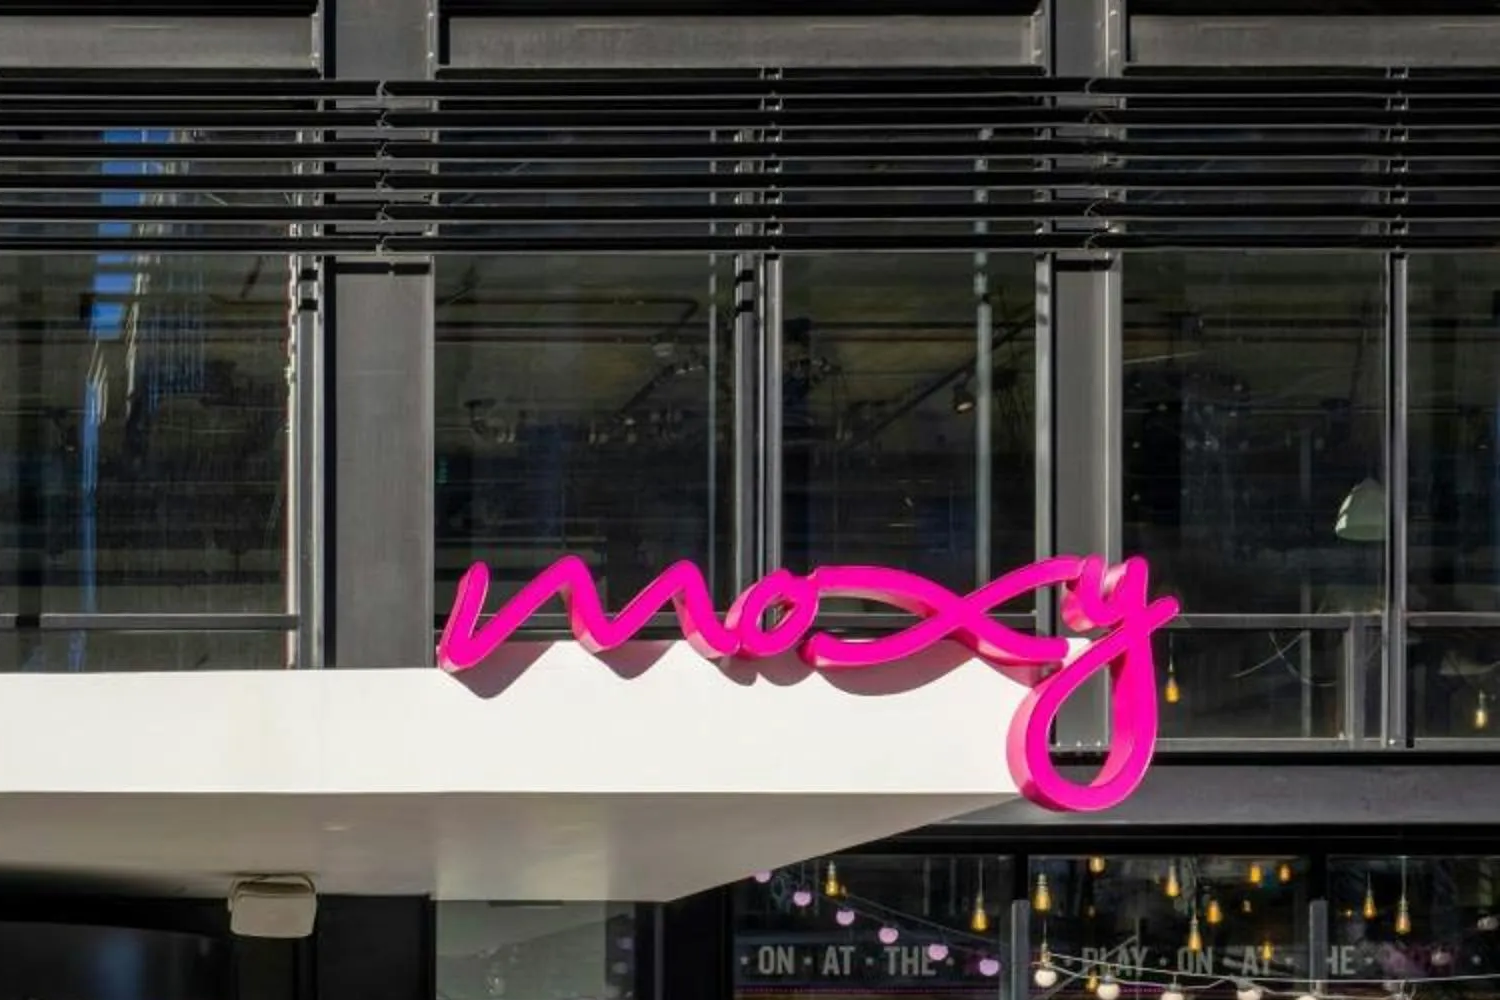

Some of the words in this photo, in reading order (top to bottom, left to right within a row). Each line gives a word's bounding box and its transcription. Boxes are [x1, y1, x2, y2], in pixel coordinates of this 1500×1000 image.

[438, 555, 1180, 811] moxy
[758, 946, 795, 976] ON
[821, 946, 855, 976] AT
[883, 946, 937, 976] THE
[1177, 946, 1213, 975] ON
[1326, 945, 1356, 975] HE
